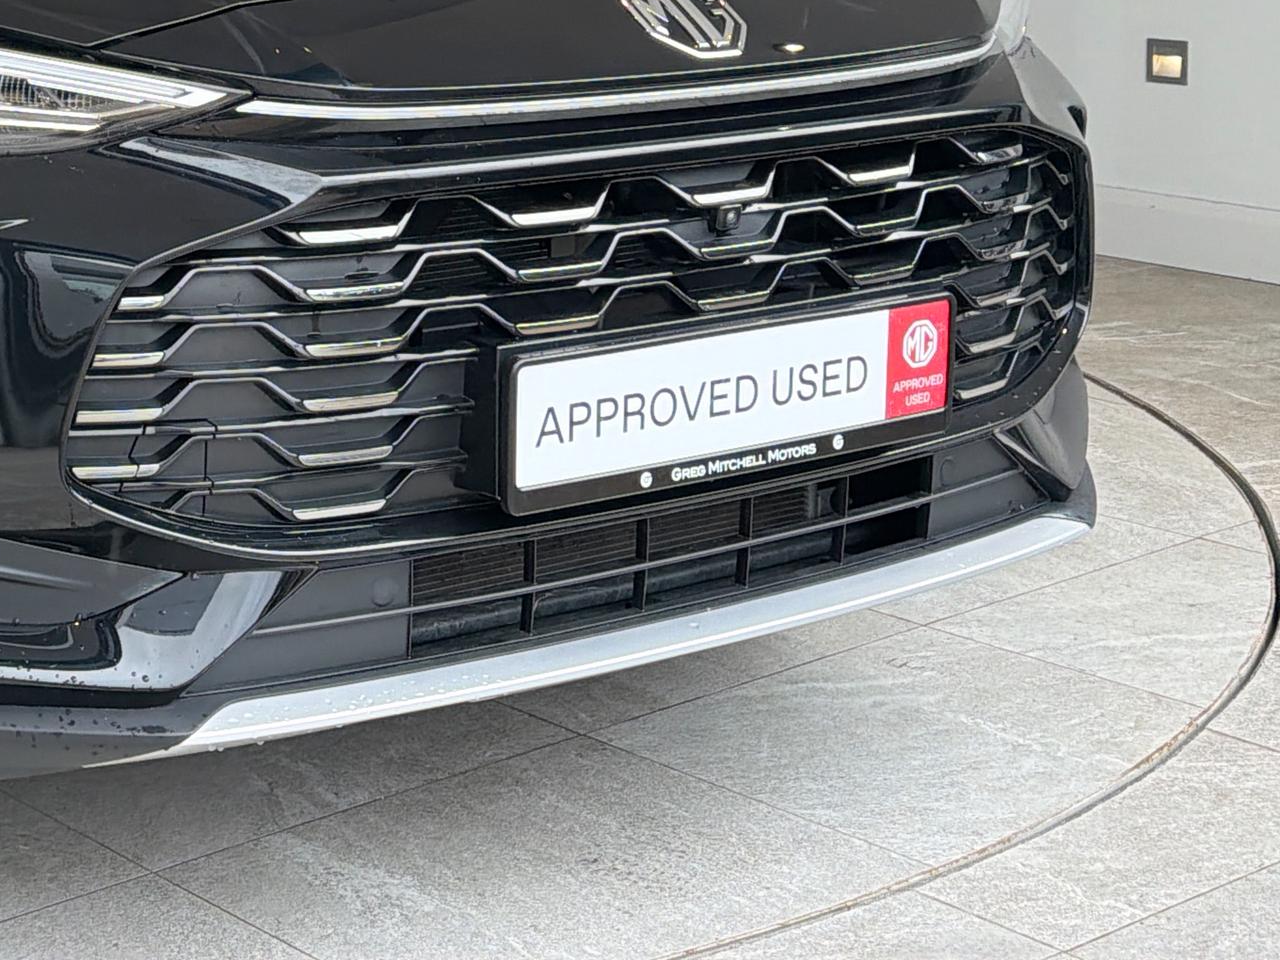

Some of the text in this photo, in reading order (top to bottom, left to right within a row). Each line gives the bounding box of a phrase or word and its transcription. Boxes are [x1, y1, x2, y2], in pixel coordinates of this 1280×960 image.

[905, 322, 936, 365] MG
[535, 355, 869, 448] APPROVED USED
[892, 373, 944, 393] APPROVED
[905, 391, 931, 407] USED
[671, 466, 707, 482] GREG
[707, 454, 767, 475] MITCHELL
[767, 443, 817, 463] MOTORS
